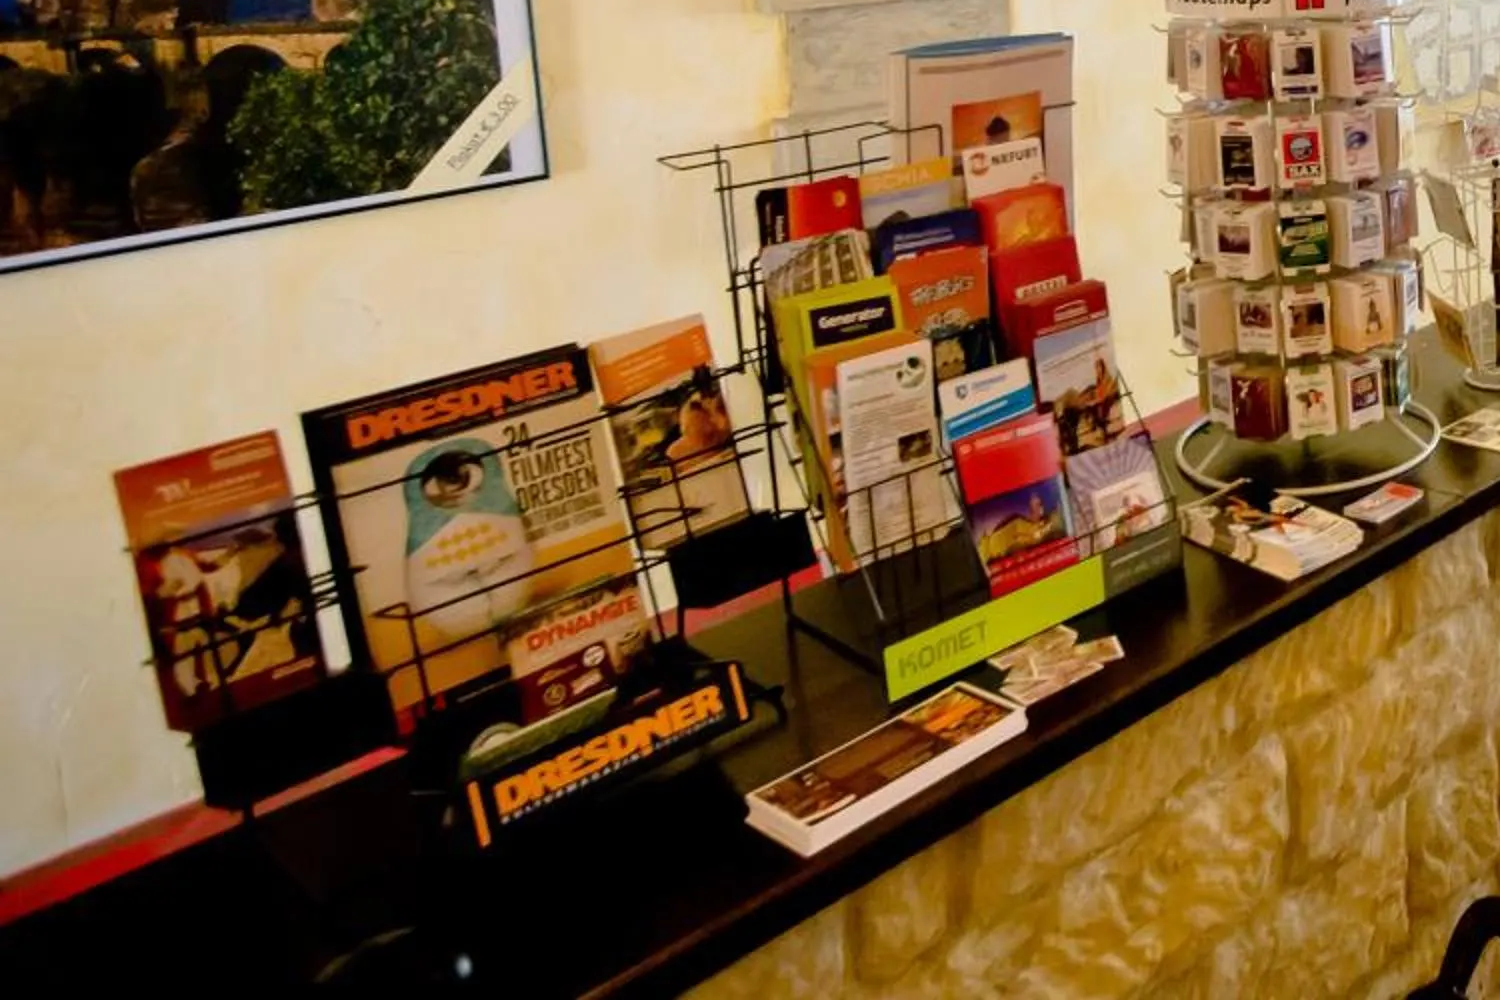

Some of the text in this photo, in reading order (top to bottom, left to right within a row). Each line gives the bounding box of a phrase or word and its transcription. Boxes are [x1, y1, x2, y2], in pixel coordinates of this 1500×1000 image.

[816, 304, 888, 330] Generator
[345, 361, 578, 449] DRESDNER
[509, 437, 595, 487] FILMFEST
[516, 466, 600, 513] DRESDEN
[898, 619, 988, 679] KOMET
[493, 685, 725, 818] DRESDNER
